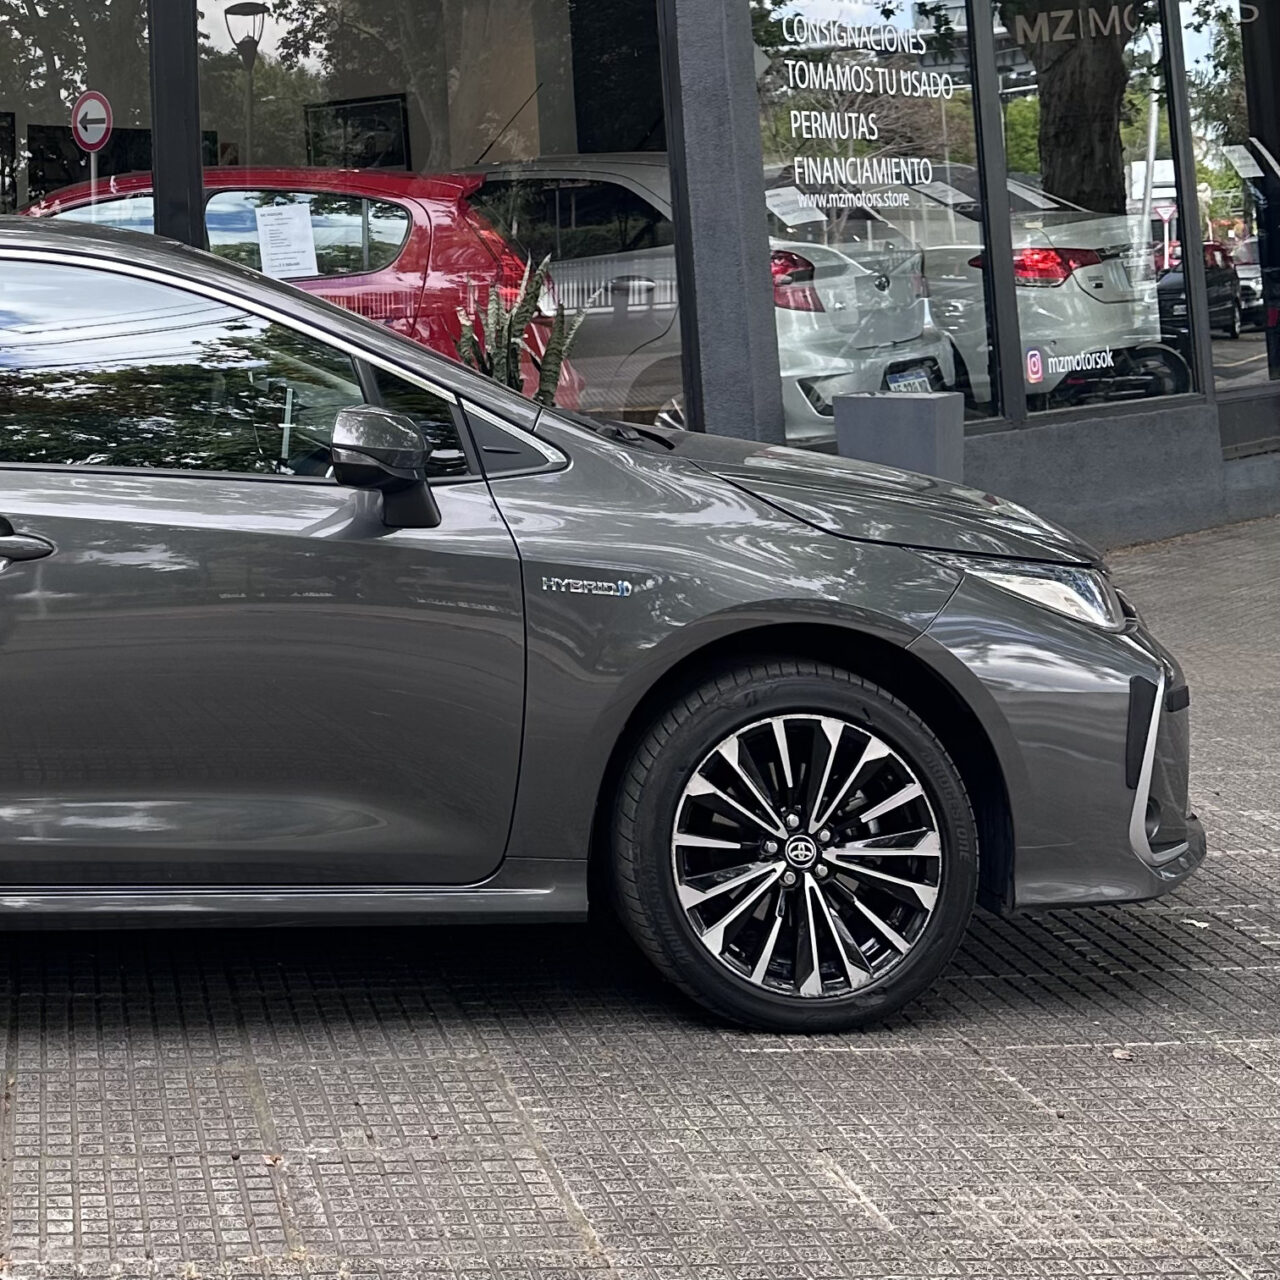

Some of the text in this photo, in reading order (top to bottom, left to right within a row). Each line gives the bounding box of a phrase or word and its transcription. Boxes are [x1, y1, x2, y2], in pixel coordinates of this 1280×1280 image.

[782, 15, 927, 55] CONSIGNACIONES
[784, 59, 954, 100] TOMAMOS TU USADO
[790, 110, 879, 140] PERMUTAS
[793, 156, 933, 185] FINANCIAMIENTO
[1047, 346, 1115, 374] mzmotorsok
